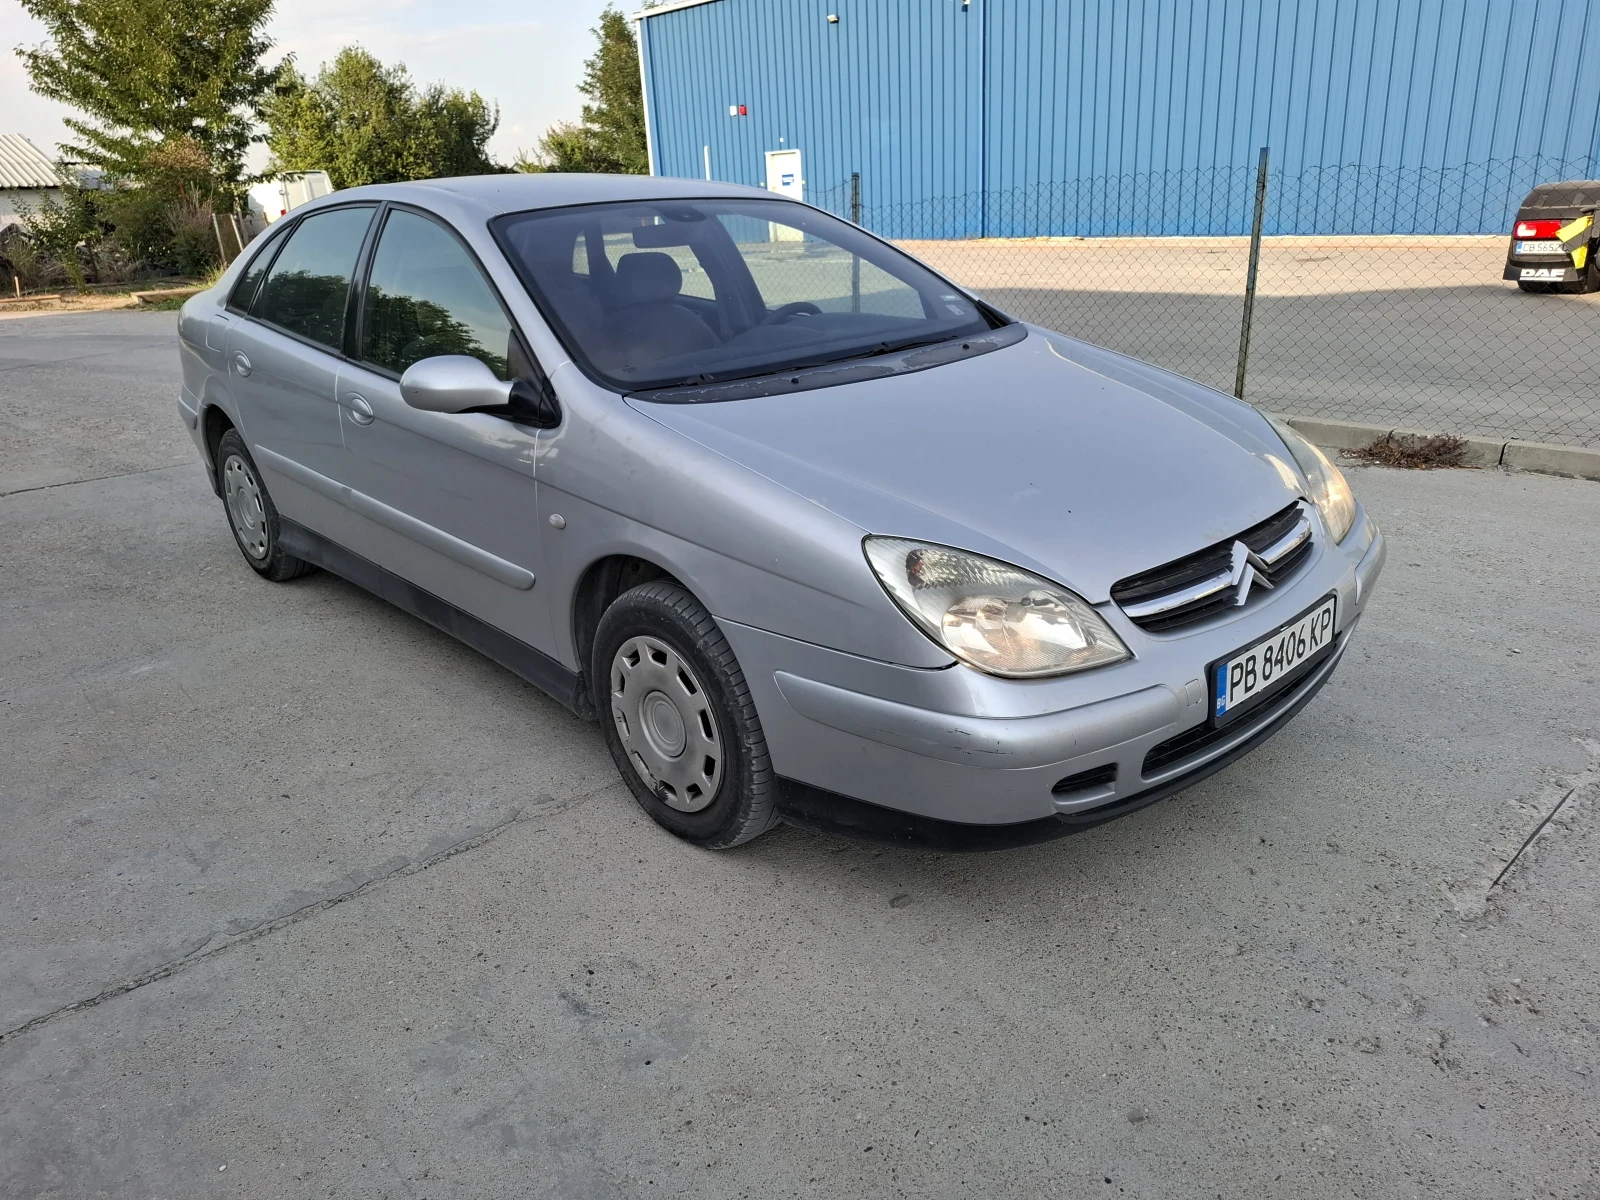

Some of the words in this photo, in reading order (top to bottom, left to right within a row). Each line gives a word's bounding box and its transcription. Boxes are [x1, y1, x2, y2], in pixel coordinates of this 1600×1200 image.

[1522, 243, 1535, 252] CB
[1520, 269, 1566, 277] DAF
[1230, 654, 1257, 703] PB
[1262, 623, 1306, 682] 8406
[1310, 607, 1331, 652] KP
[1216, 695, 1226, 709] BG
